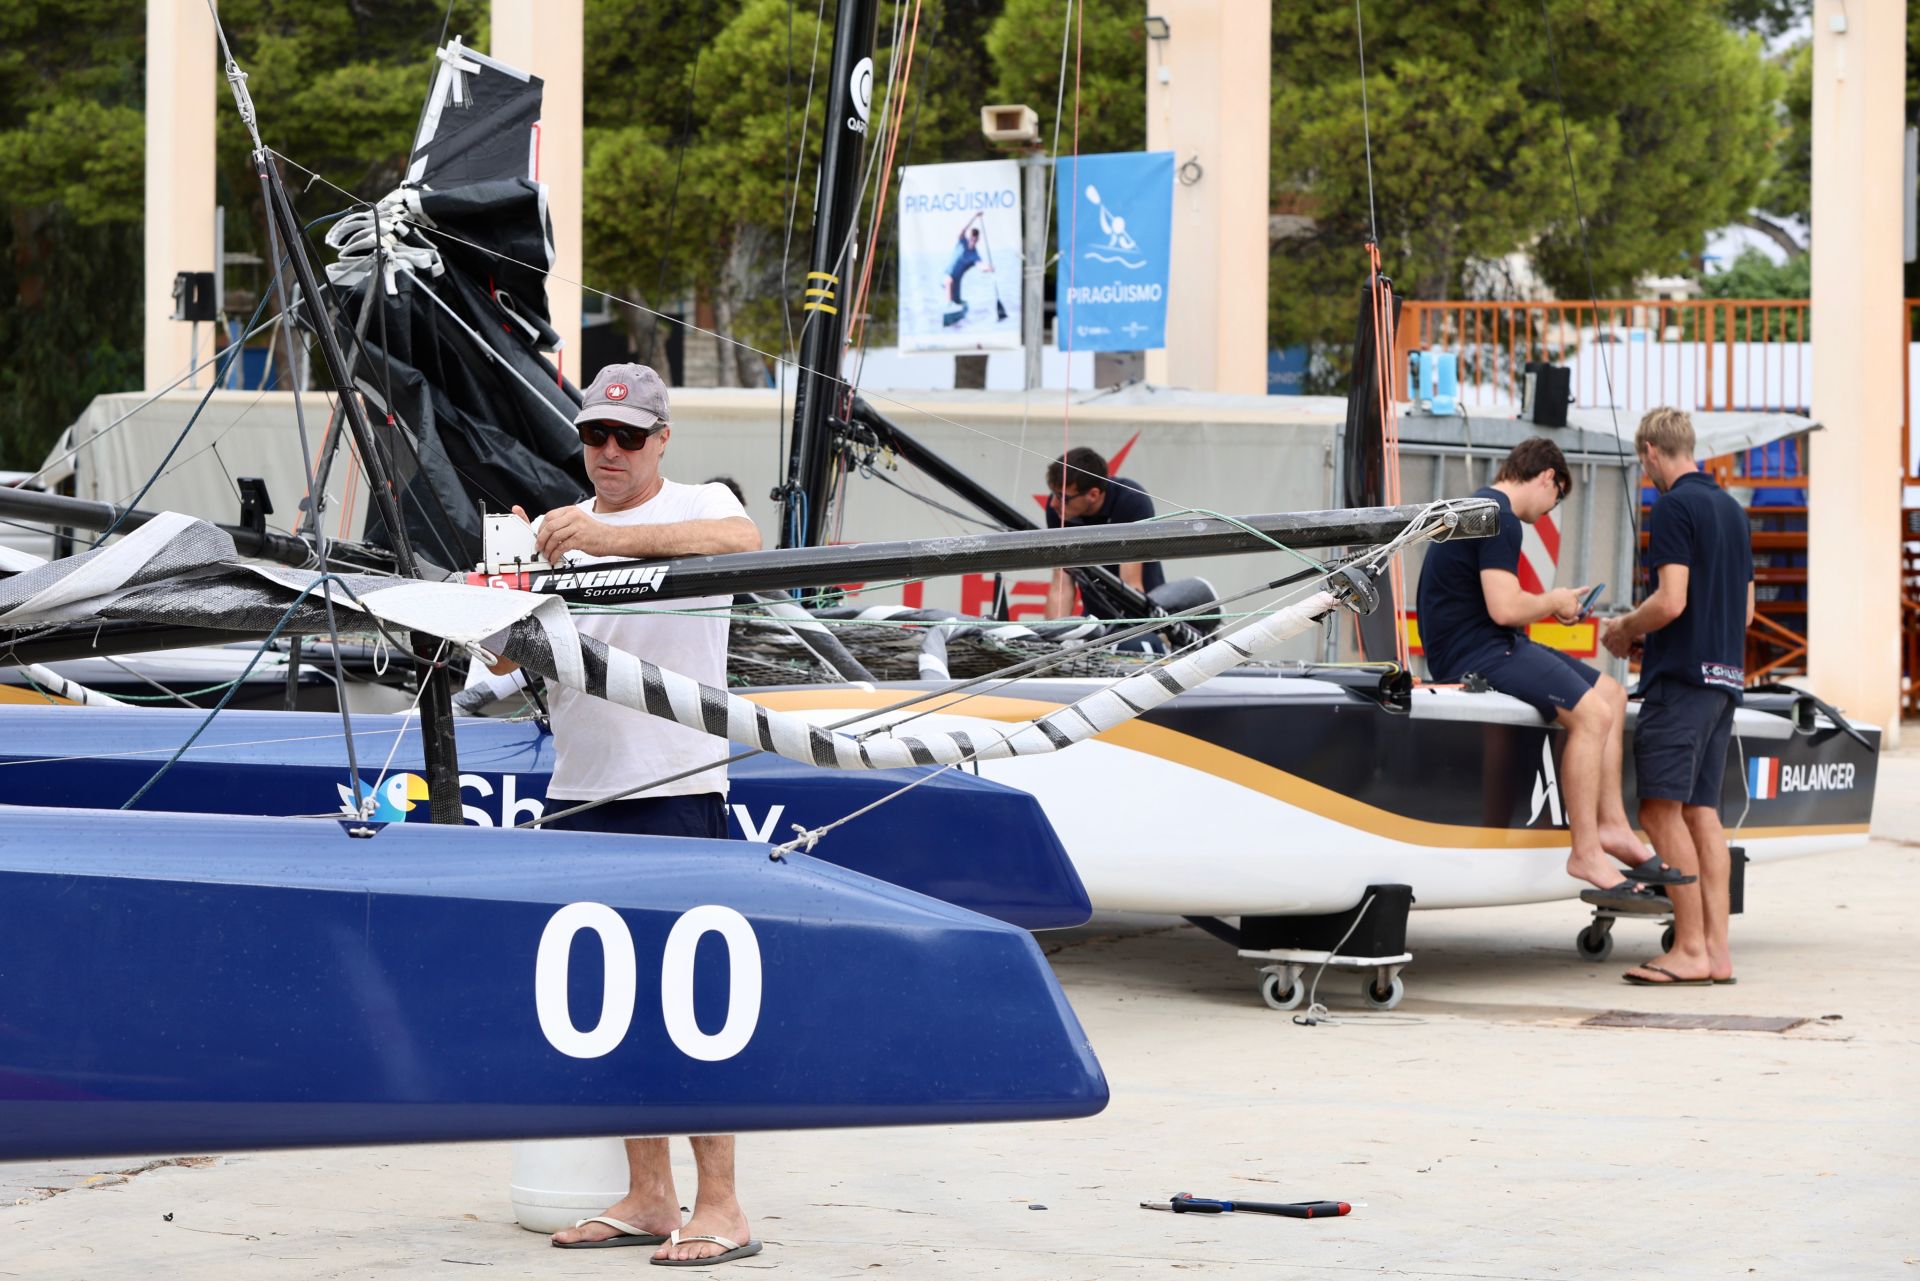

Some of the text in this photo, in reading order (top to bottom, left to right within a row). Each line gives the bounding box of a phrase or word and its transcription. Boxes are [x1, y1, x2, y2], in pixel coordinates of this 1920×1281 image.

[905, 187, 1016, 213] PIRAGÜISMO
[1066, 281, 1162, 304] PIRAGÜISMO
[531, 565, 670, 593] racing
[583, 585, 649, 598] Soromap
[1781, 762, 1856, 792] BALANGER
[535, 901, 762, 1062] 00
